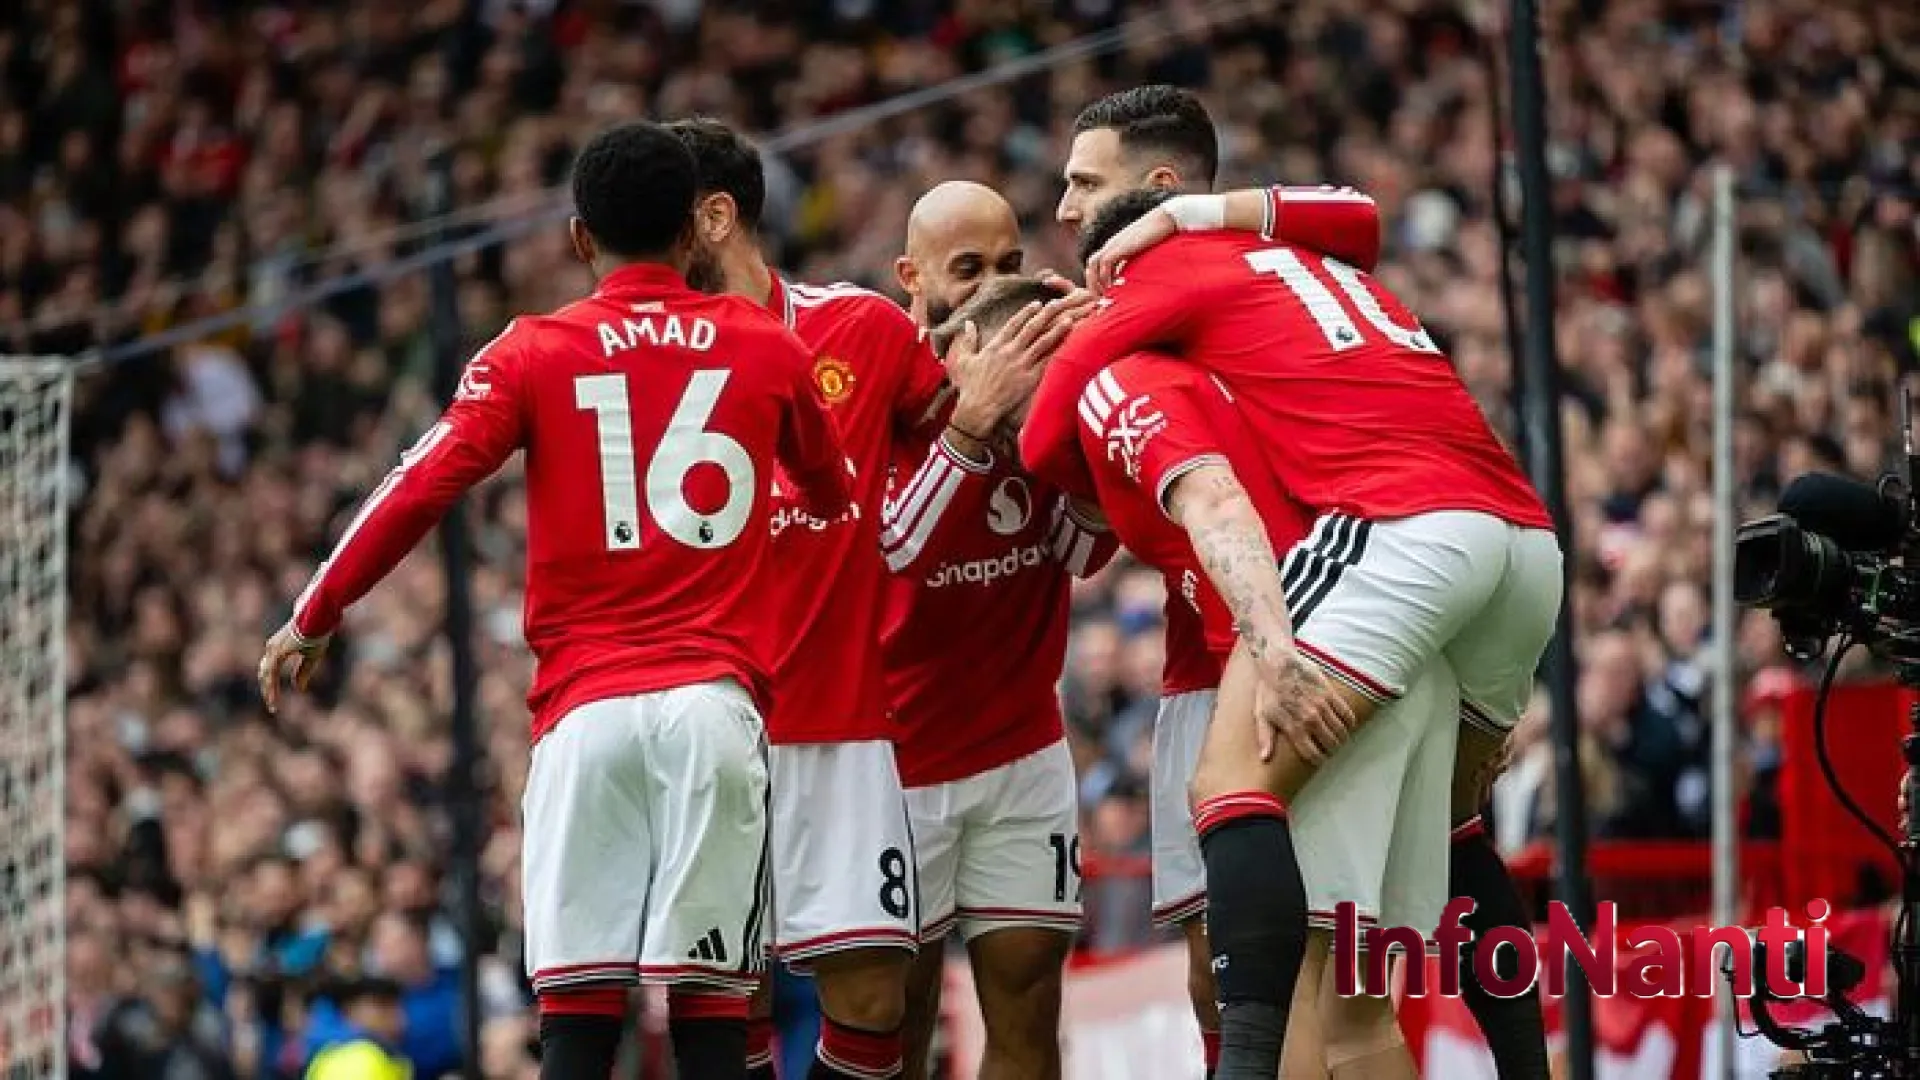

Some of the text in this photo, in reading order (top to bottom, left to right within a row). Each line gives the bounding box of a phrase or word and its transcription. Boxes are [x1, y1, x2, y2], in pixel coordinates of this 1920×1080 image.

[597, 315, 717, 356] AMAD
[574, 368, 756, 551] 16
[879, 846, 909, 918] 8
